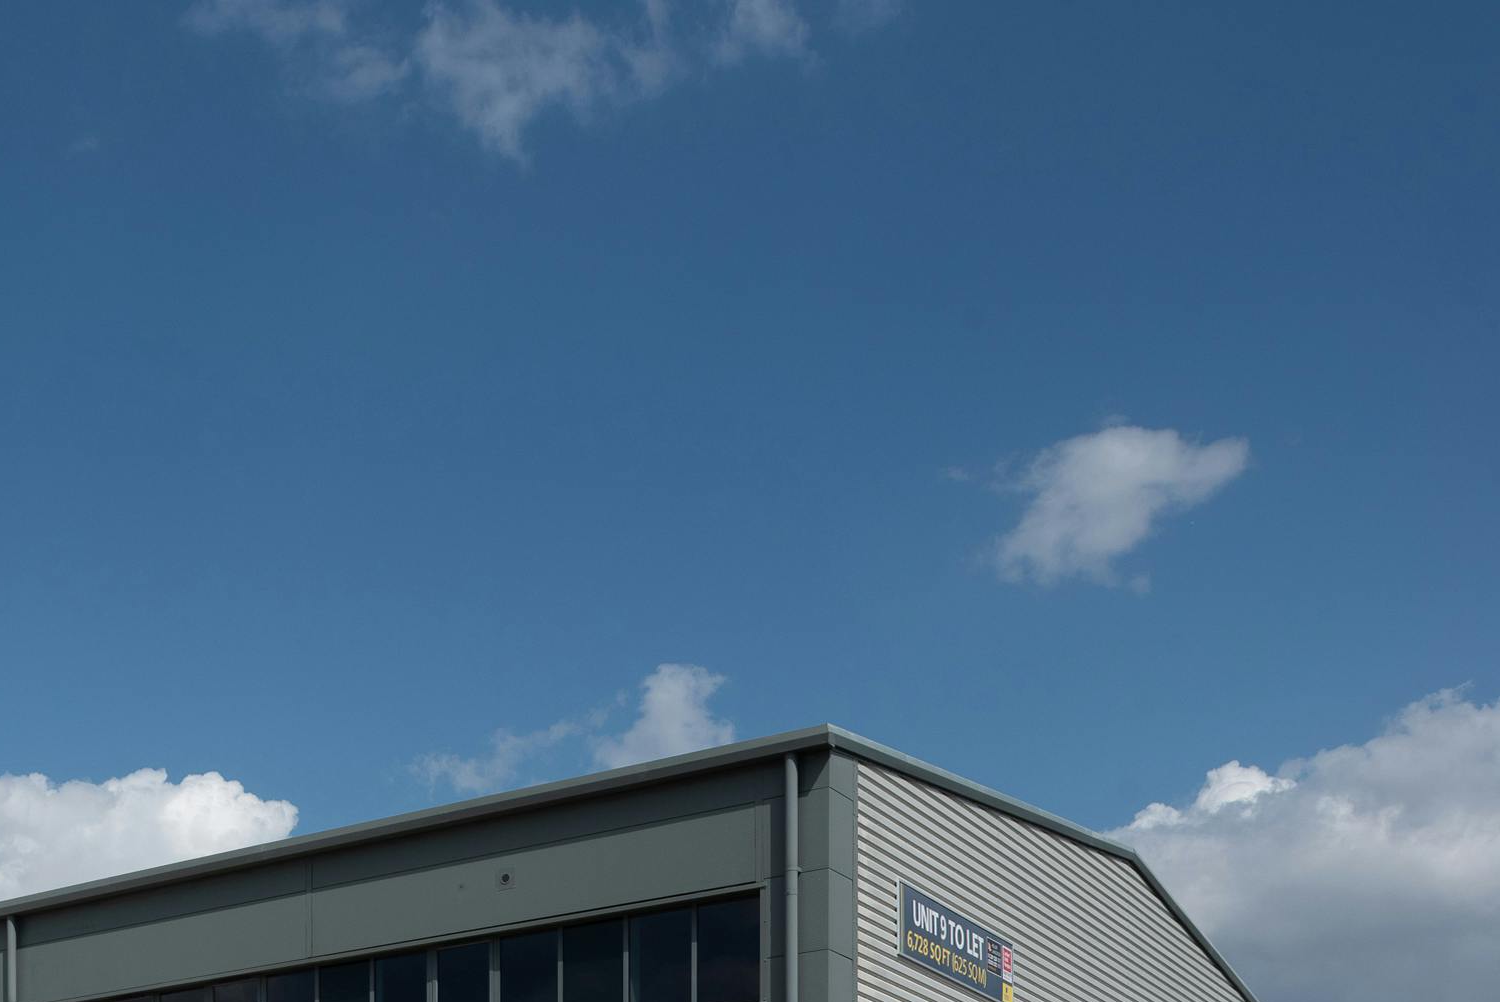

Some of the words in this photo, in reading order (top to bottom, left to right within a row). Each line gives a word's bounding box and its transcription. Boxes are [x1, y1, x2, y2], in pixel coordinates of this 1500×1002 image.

[907, 930, 929, 956] 6,728
[952, 952, 967, 976] (625
[912, 899, 939, 936] UNIT
[940, 914, 947, 940] 9
[948, 919, 964, 950] TO
[966, 928, 984, 961] LET
